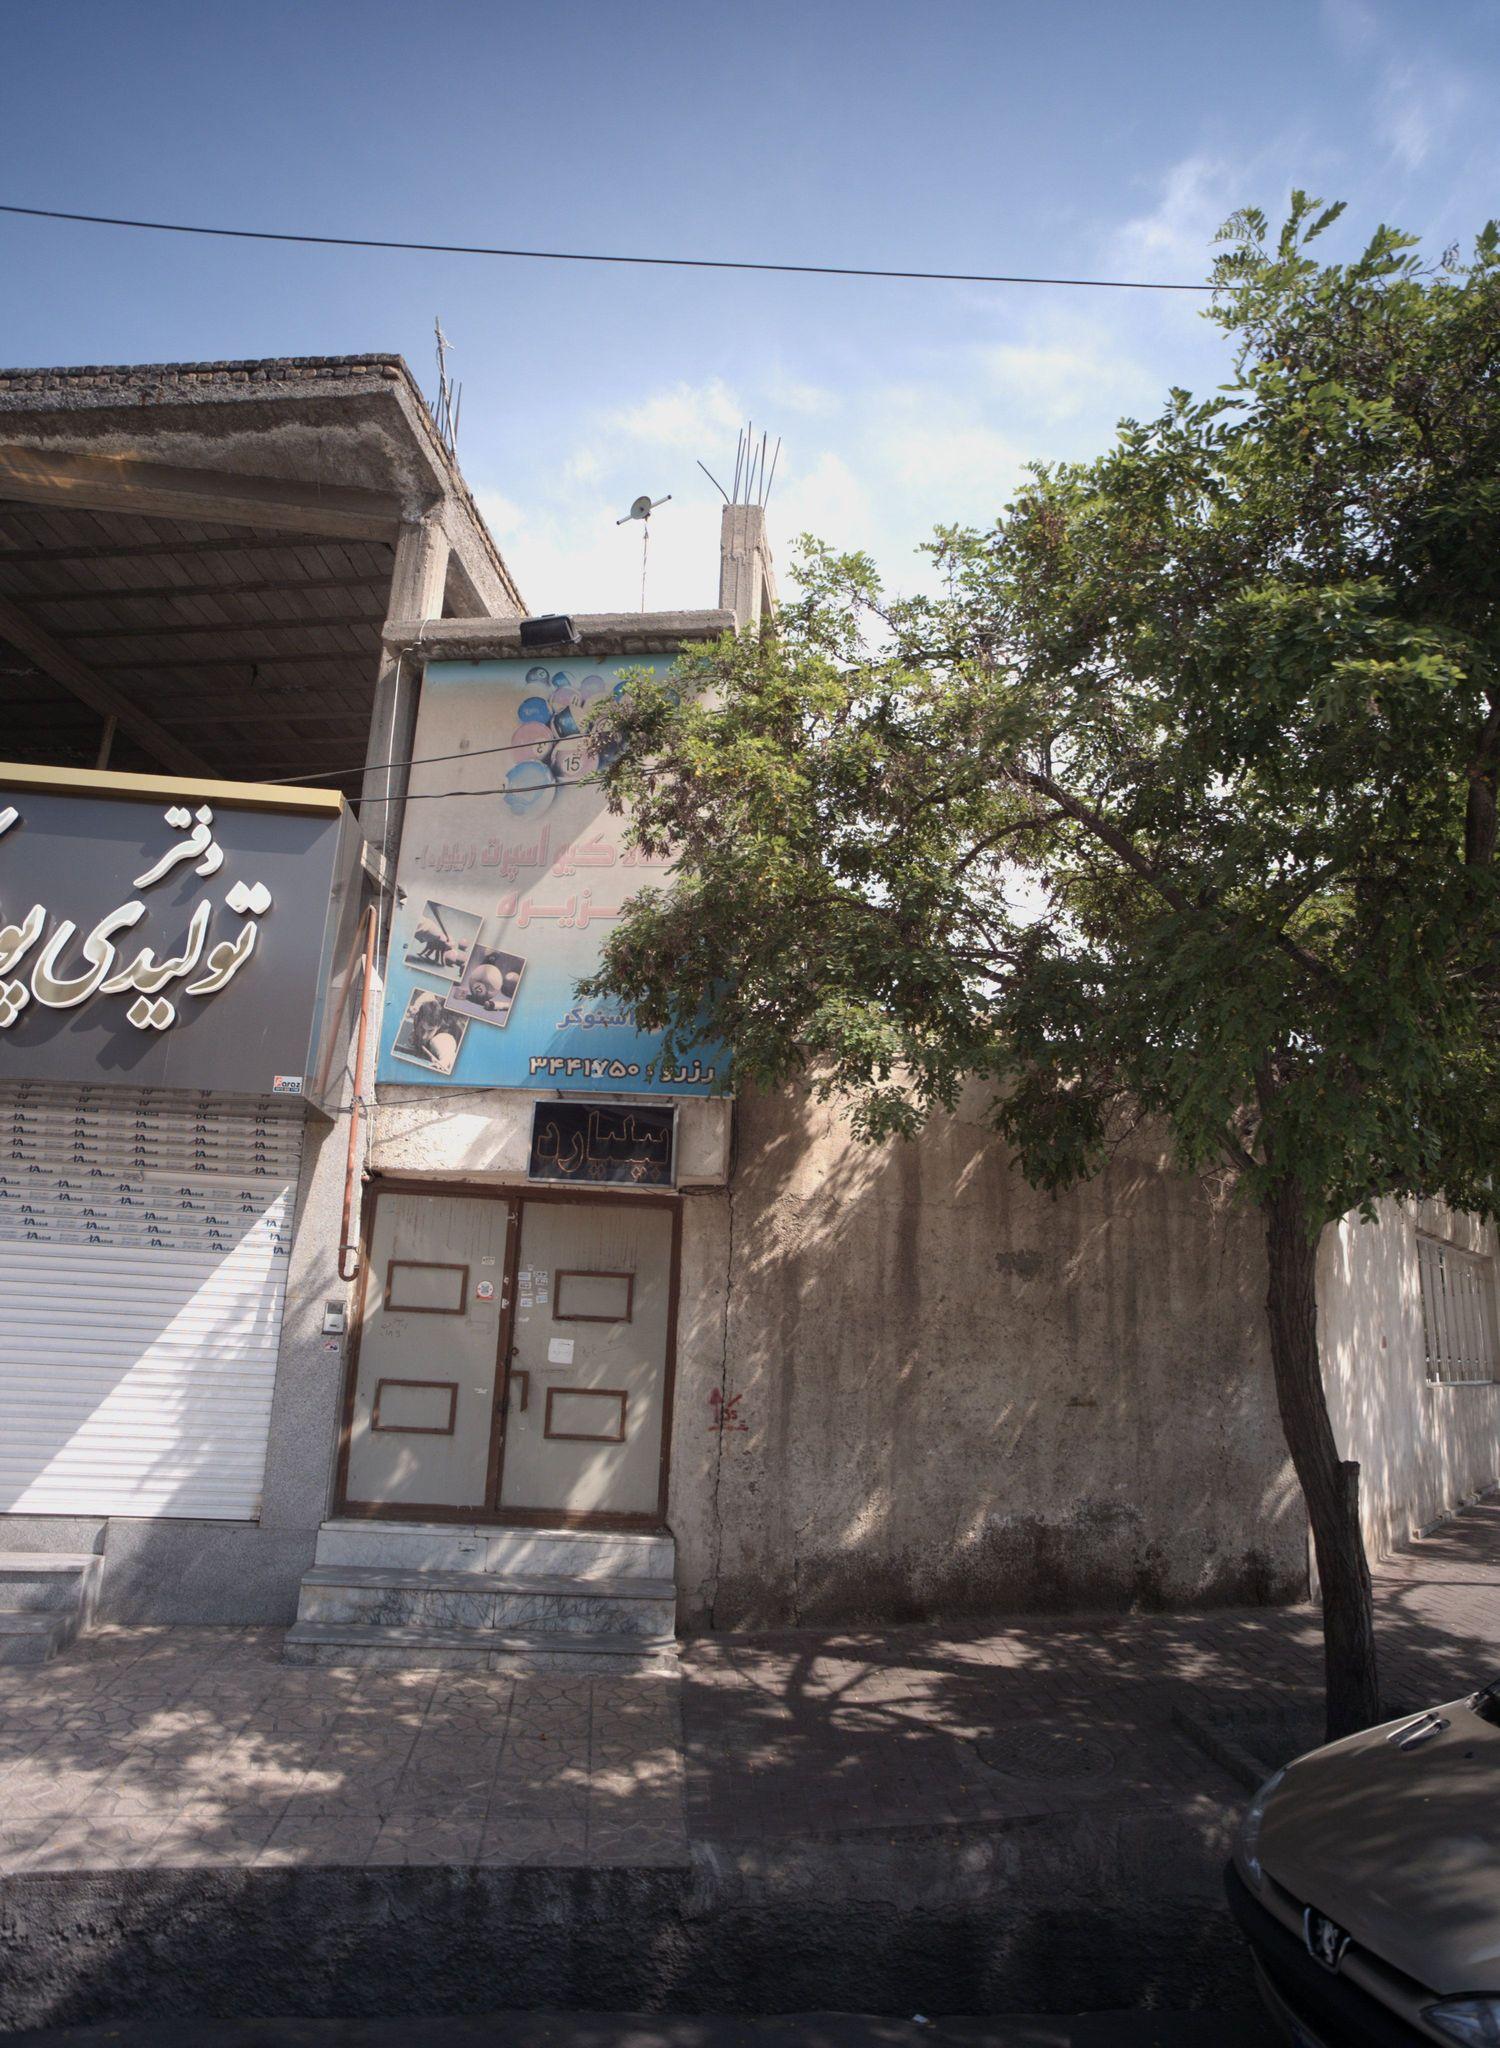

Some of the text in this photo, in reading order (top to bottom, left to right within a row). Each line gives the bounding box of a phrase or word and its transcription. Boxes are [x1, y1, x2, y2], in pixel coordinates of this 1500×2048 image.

[564, 756, 581, 772] 15
[133, 804, 224, 889] دفتر
[31, 881, 272, 1030] تولیدی
[537, 1110, 670, 1179] بیلیارد
